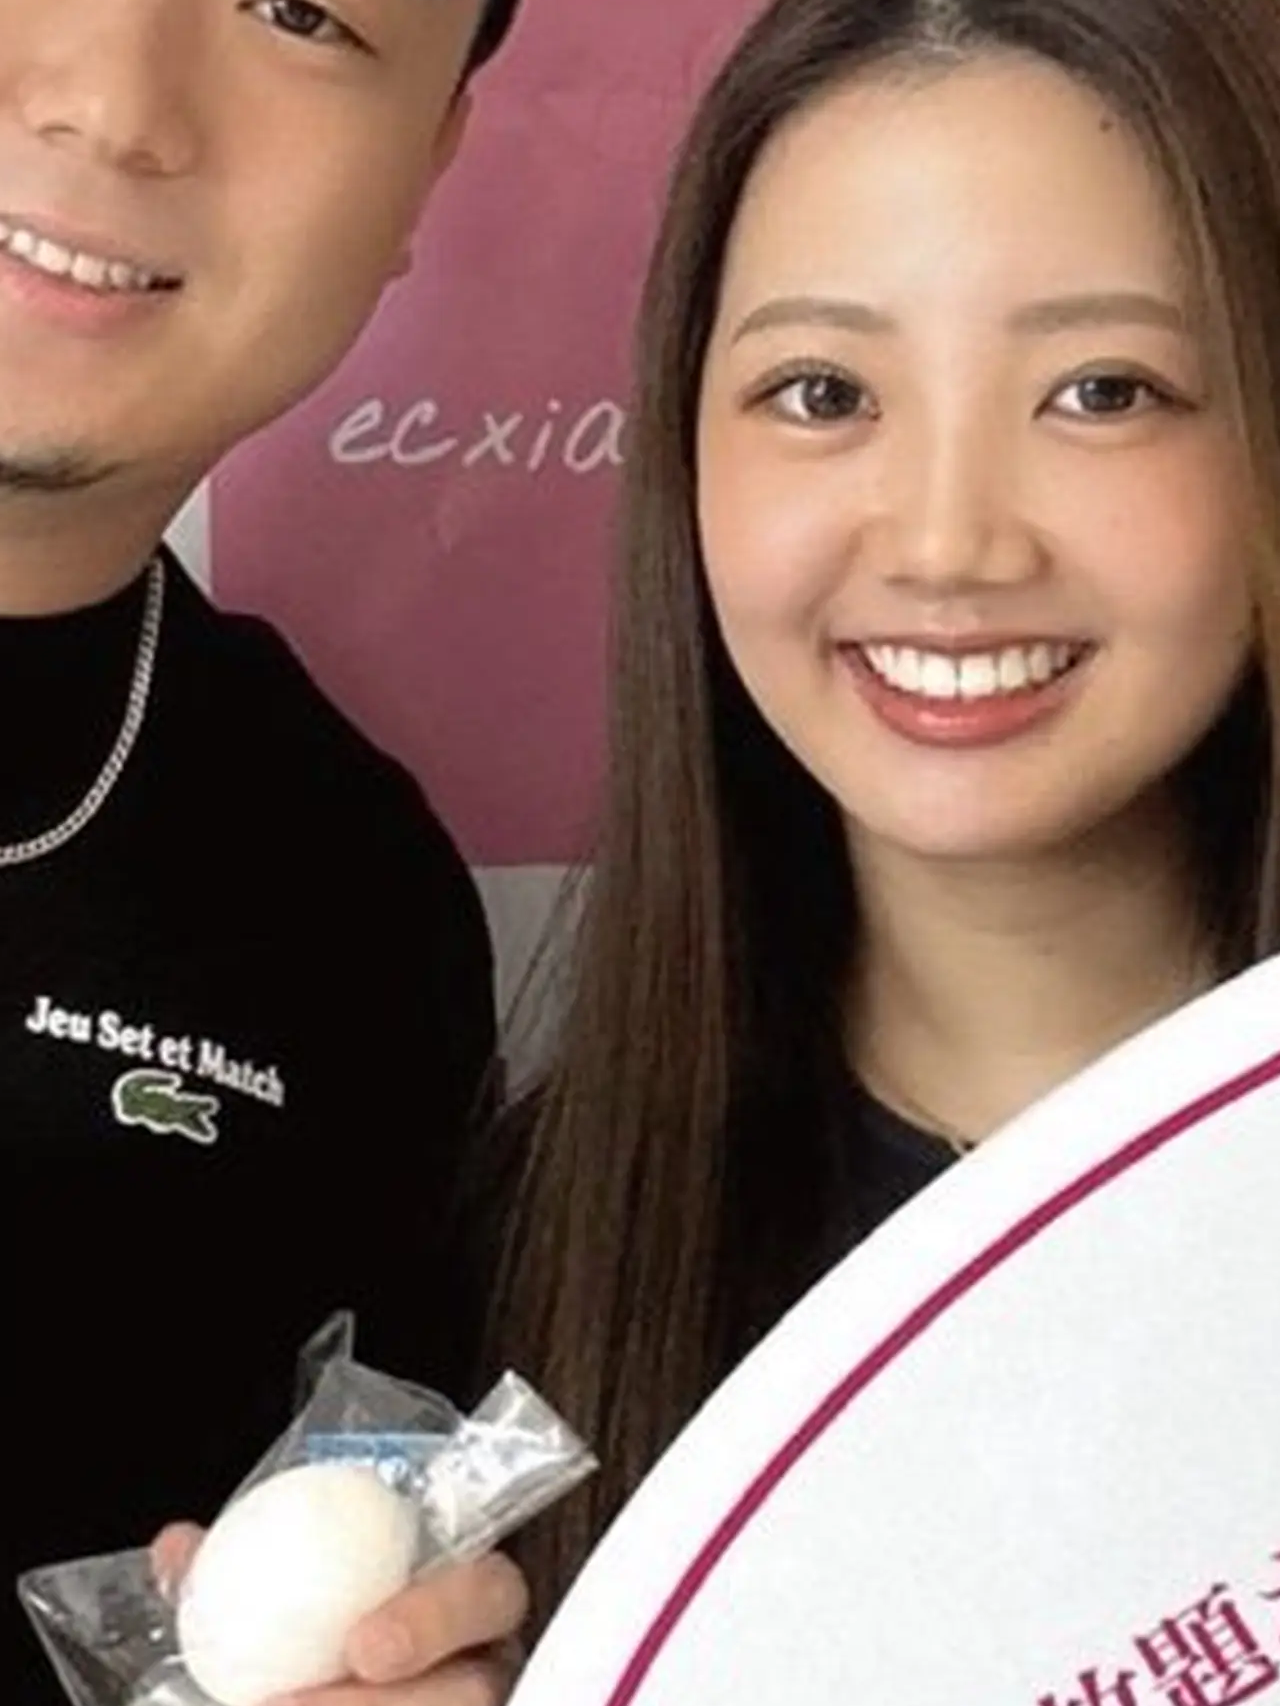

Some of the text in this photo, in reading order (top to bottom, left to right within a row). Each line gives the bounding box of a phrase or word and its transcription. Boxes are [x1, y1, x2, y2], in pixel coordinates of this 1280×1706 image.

[328, 397, 624, 473] ecxia
[26, 996, 284, 1106] Jeu Set et Match
